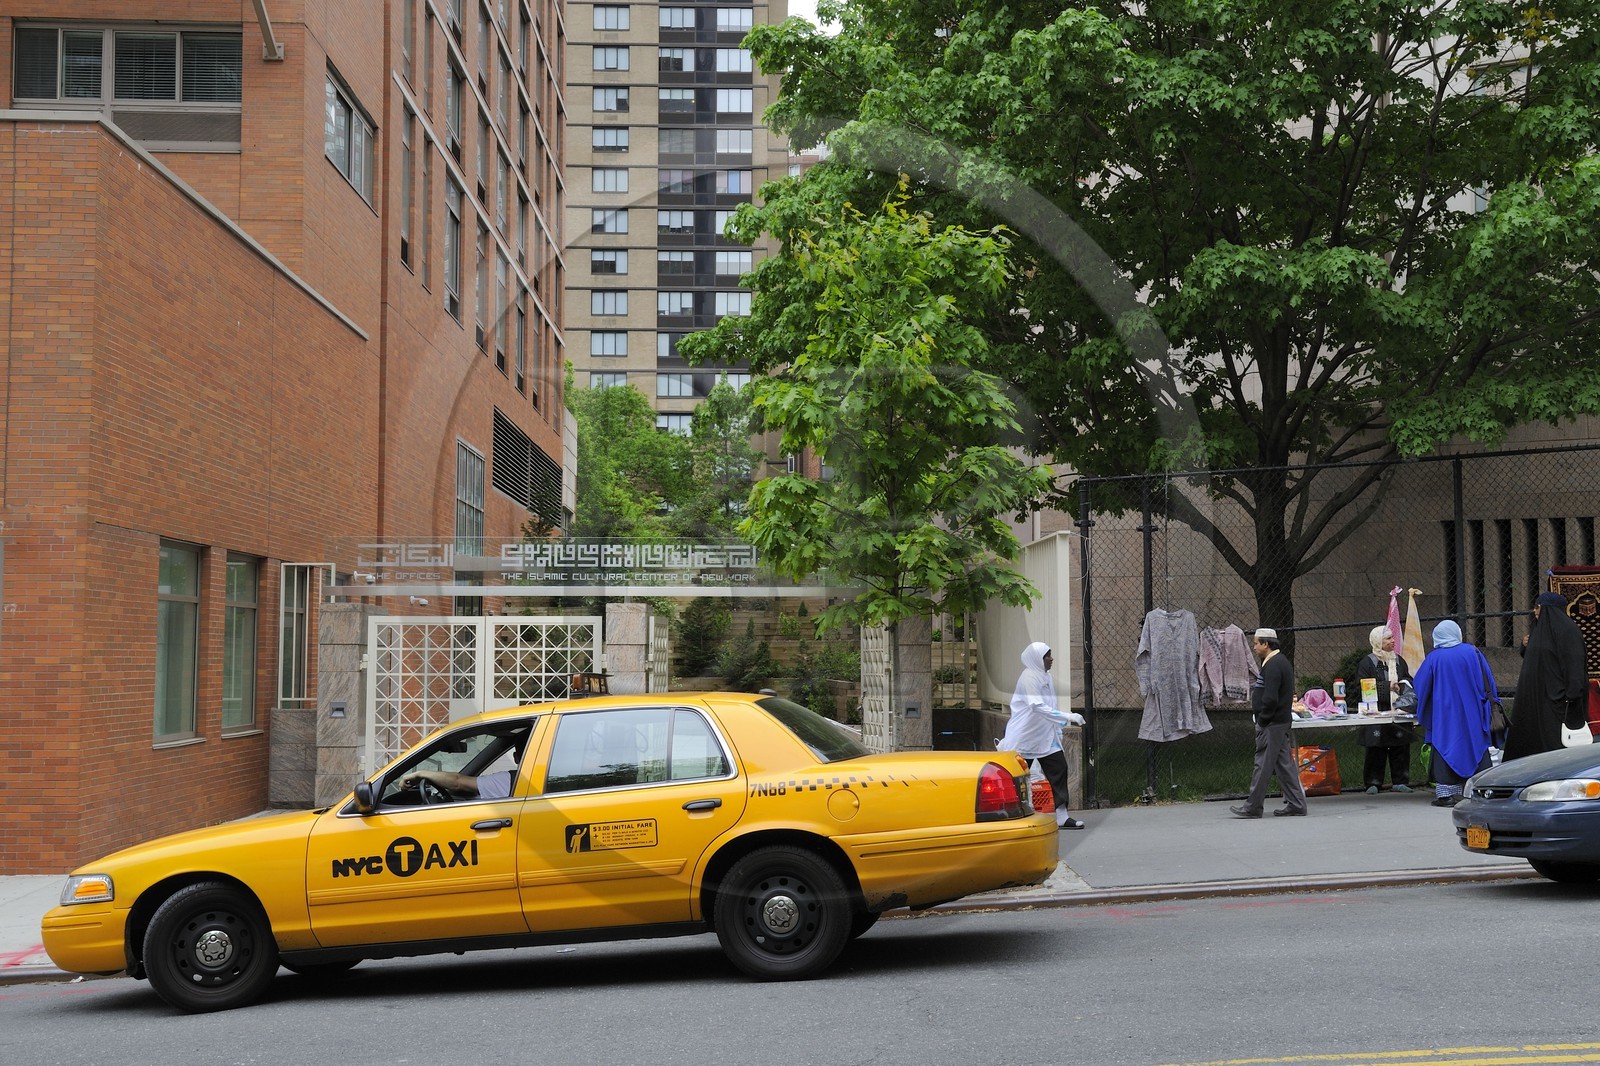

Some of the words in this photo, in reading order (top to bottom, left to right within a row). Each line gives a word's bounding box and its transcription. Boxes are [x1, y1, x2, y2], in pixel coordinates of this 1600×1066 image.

[395, 572, 441, 580] OFFICES
[501, 572, 523, 580] THE
[527, 572, 568, 581] ISLAMIC
[572, 573, 630, 581] CULTURAL
[634, 573, 678, 581] CENTER
[683, 573, 697, 581] OF
[701, 573, 723, 581] NEW
[728, 573, 756, 581] YORK
[750, 781, 786, 798] 7N68
[332, 856, 383, 878] NYC
[387, 838, 478, 875] TAXI
